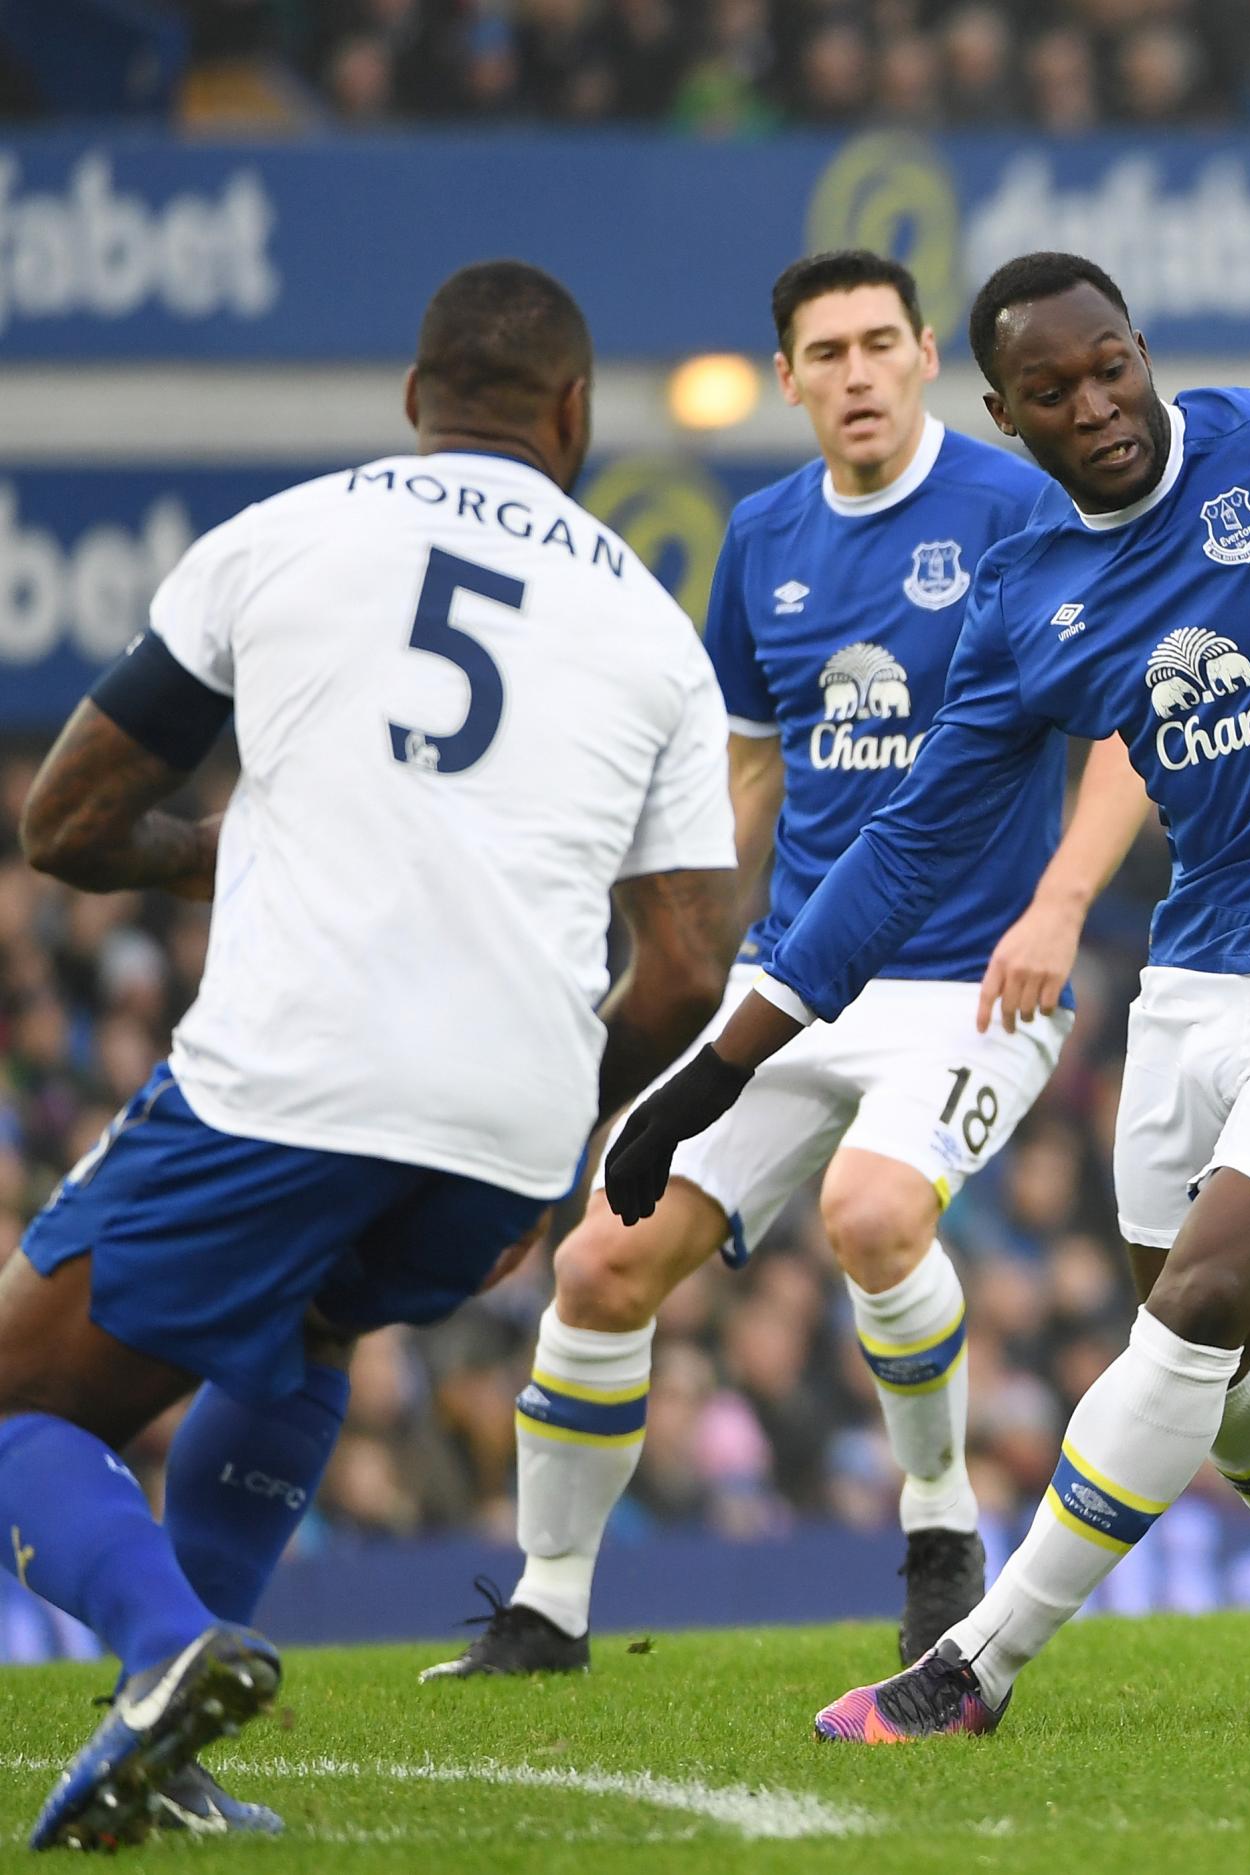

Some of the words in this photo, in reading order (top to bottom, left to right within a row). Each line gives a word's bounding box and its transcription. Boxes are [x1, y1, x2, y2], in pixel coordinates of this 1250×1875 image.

[347, 467, 625, 578] MORGAN
[385, 540, 529, 775] 5
[1057, 621, 1086, 642] umbro
[938, 1066, 998, 1156] 18
[219, 1462, 306, 1510] LCFC
